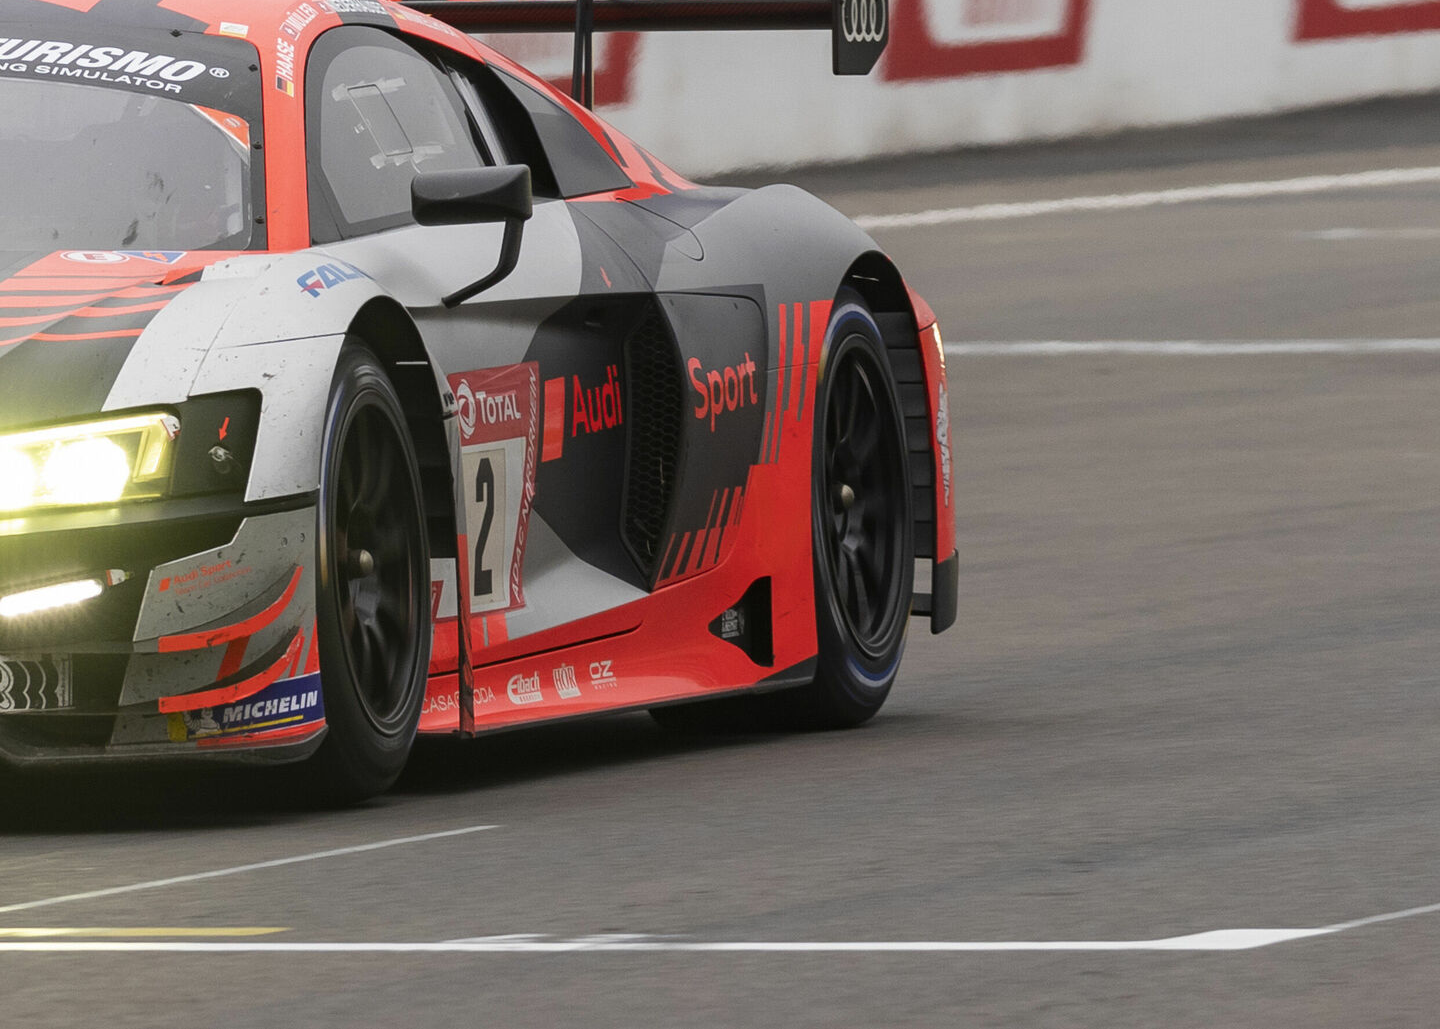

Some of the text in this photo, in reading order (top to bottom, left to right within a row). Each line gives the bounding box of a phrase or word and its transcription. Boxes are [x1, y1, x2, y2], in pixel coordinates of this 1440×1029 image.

[275, 37, 295, 82] HAASE
[33, 64, 183, 94] SIMULATOR
[296, 262, 366, 298] FAL
[476, 391, 521, 424] TOTAL
[571, 352, 757, 437] Audi Sport
[473, 458, 495, 596] 2
[222, 690, 318, 723] MICHELIN
[422, 687, 496, 714] CASAODA
